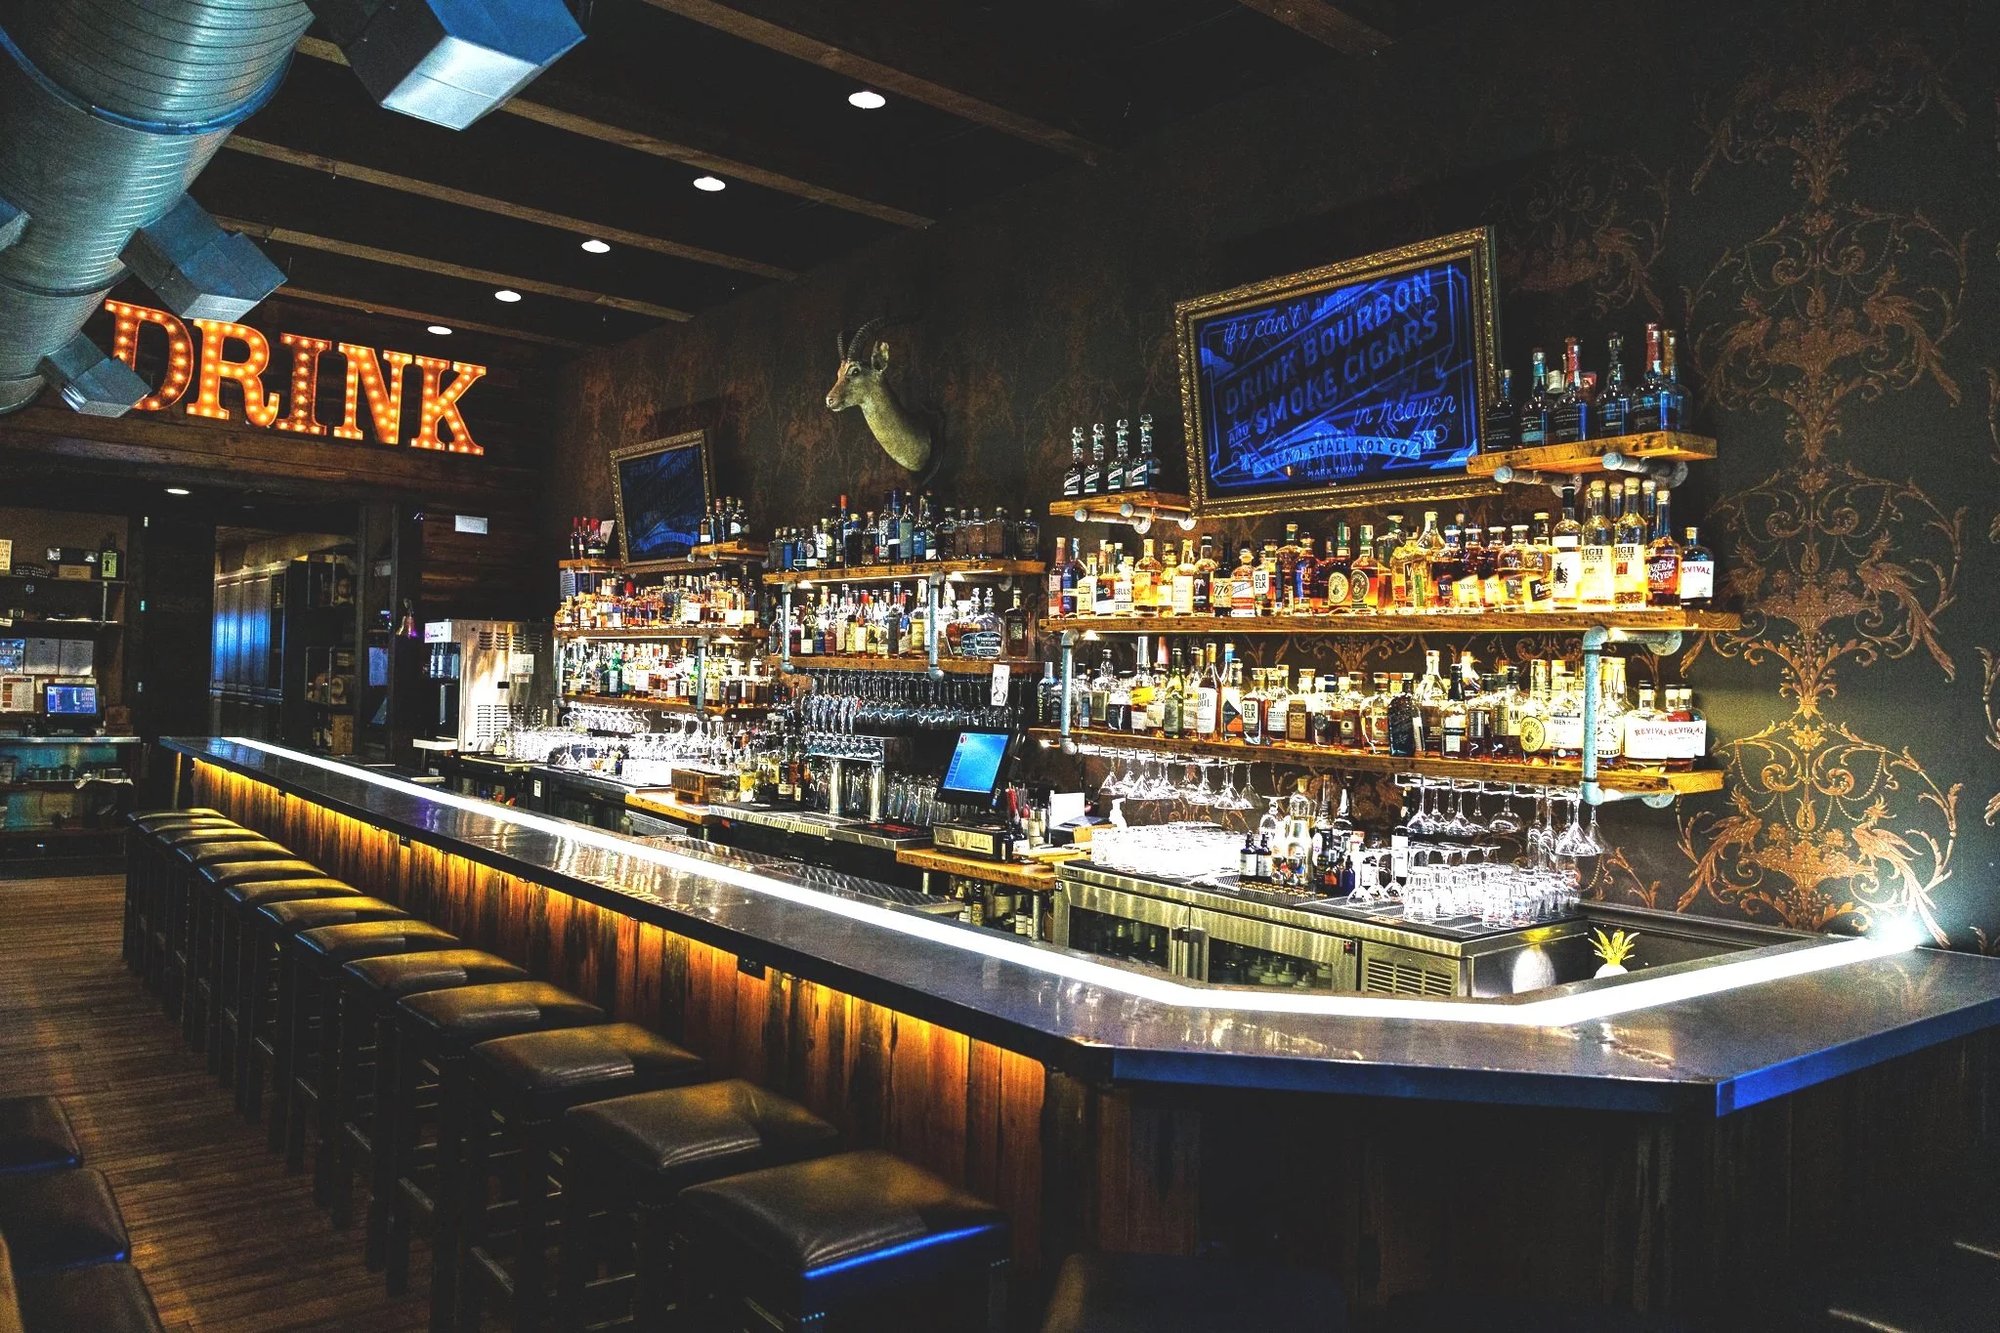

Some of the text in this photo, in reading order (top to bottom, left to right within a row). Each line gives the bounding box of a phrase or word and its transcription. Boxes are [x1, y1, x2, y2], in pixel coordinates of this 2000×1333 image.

[1226, 269, 1432, 415] DRINK BOURBON
[104, 299, 487, 456] DRINK
[1228, 309, 1440, 444] AND SMOKE CIGARS
[1379, 395, 1457, 424] heaven
[1308, 440, 1350, 456] SHALL
[1356, 440, 1384, 453] NOT
[1389, 442, 1408, 454] GO
[1307, 467, 1332, 478] MARK
[1335, 463, 1365, 474] TWAIN
[1244, 703, 1256, 711] OLD
[1244, 711, 1256, 719] ELK
[1634, 727, 1667, 737] REVIVAL
[1055, 881, 1063, 890] 15
